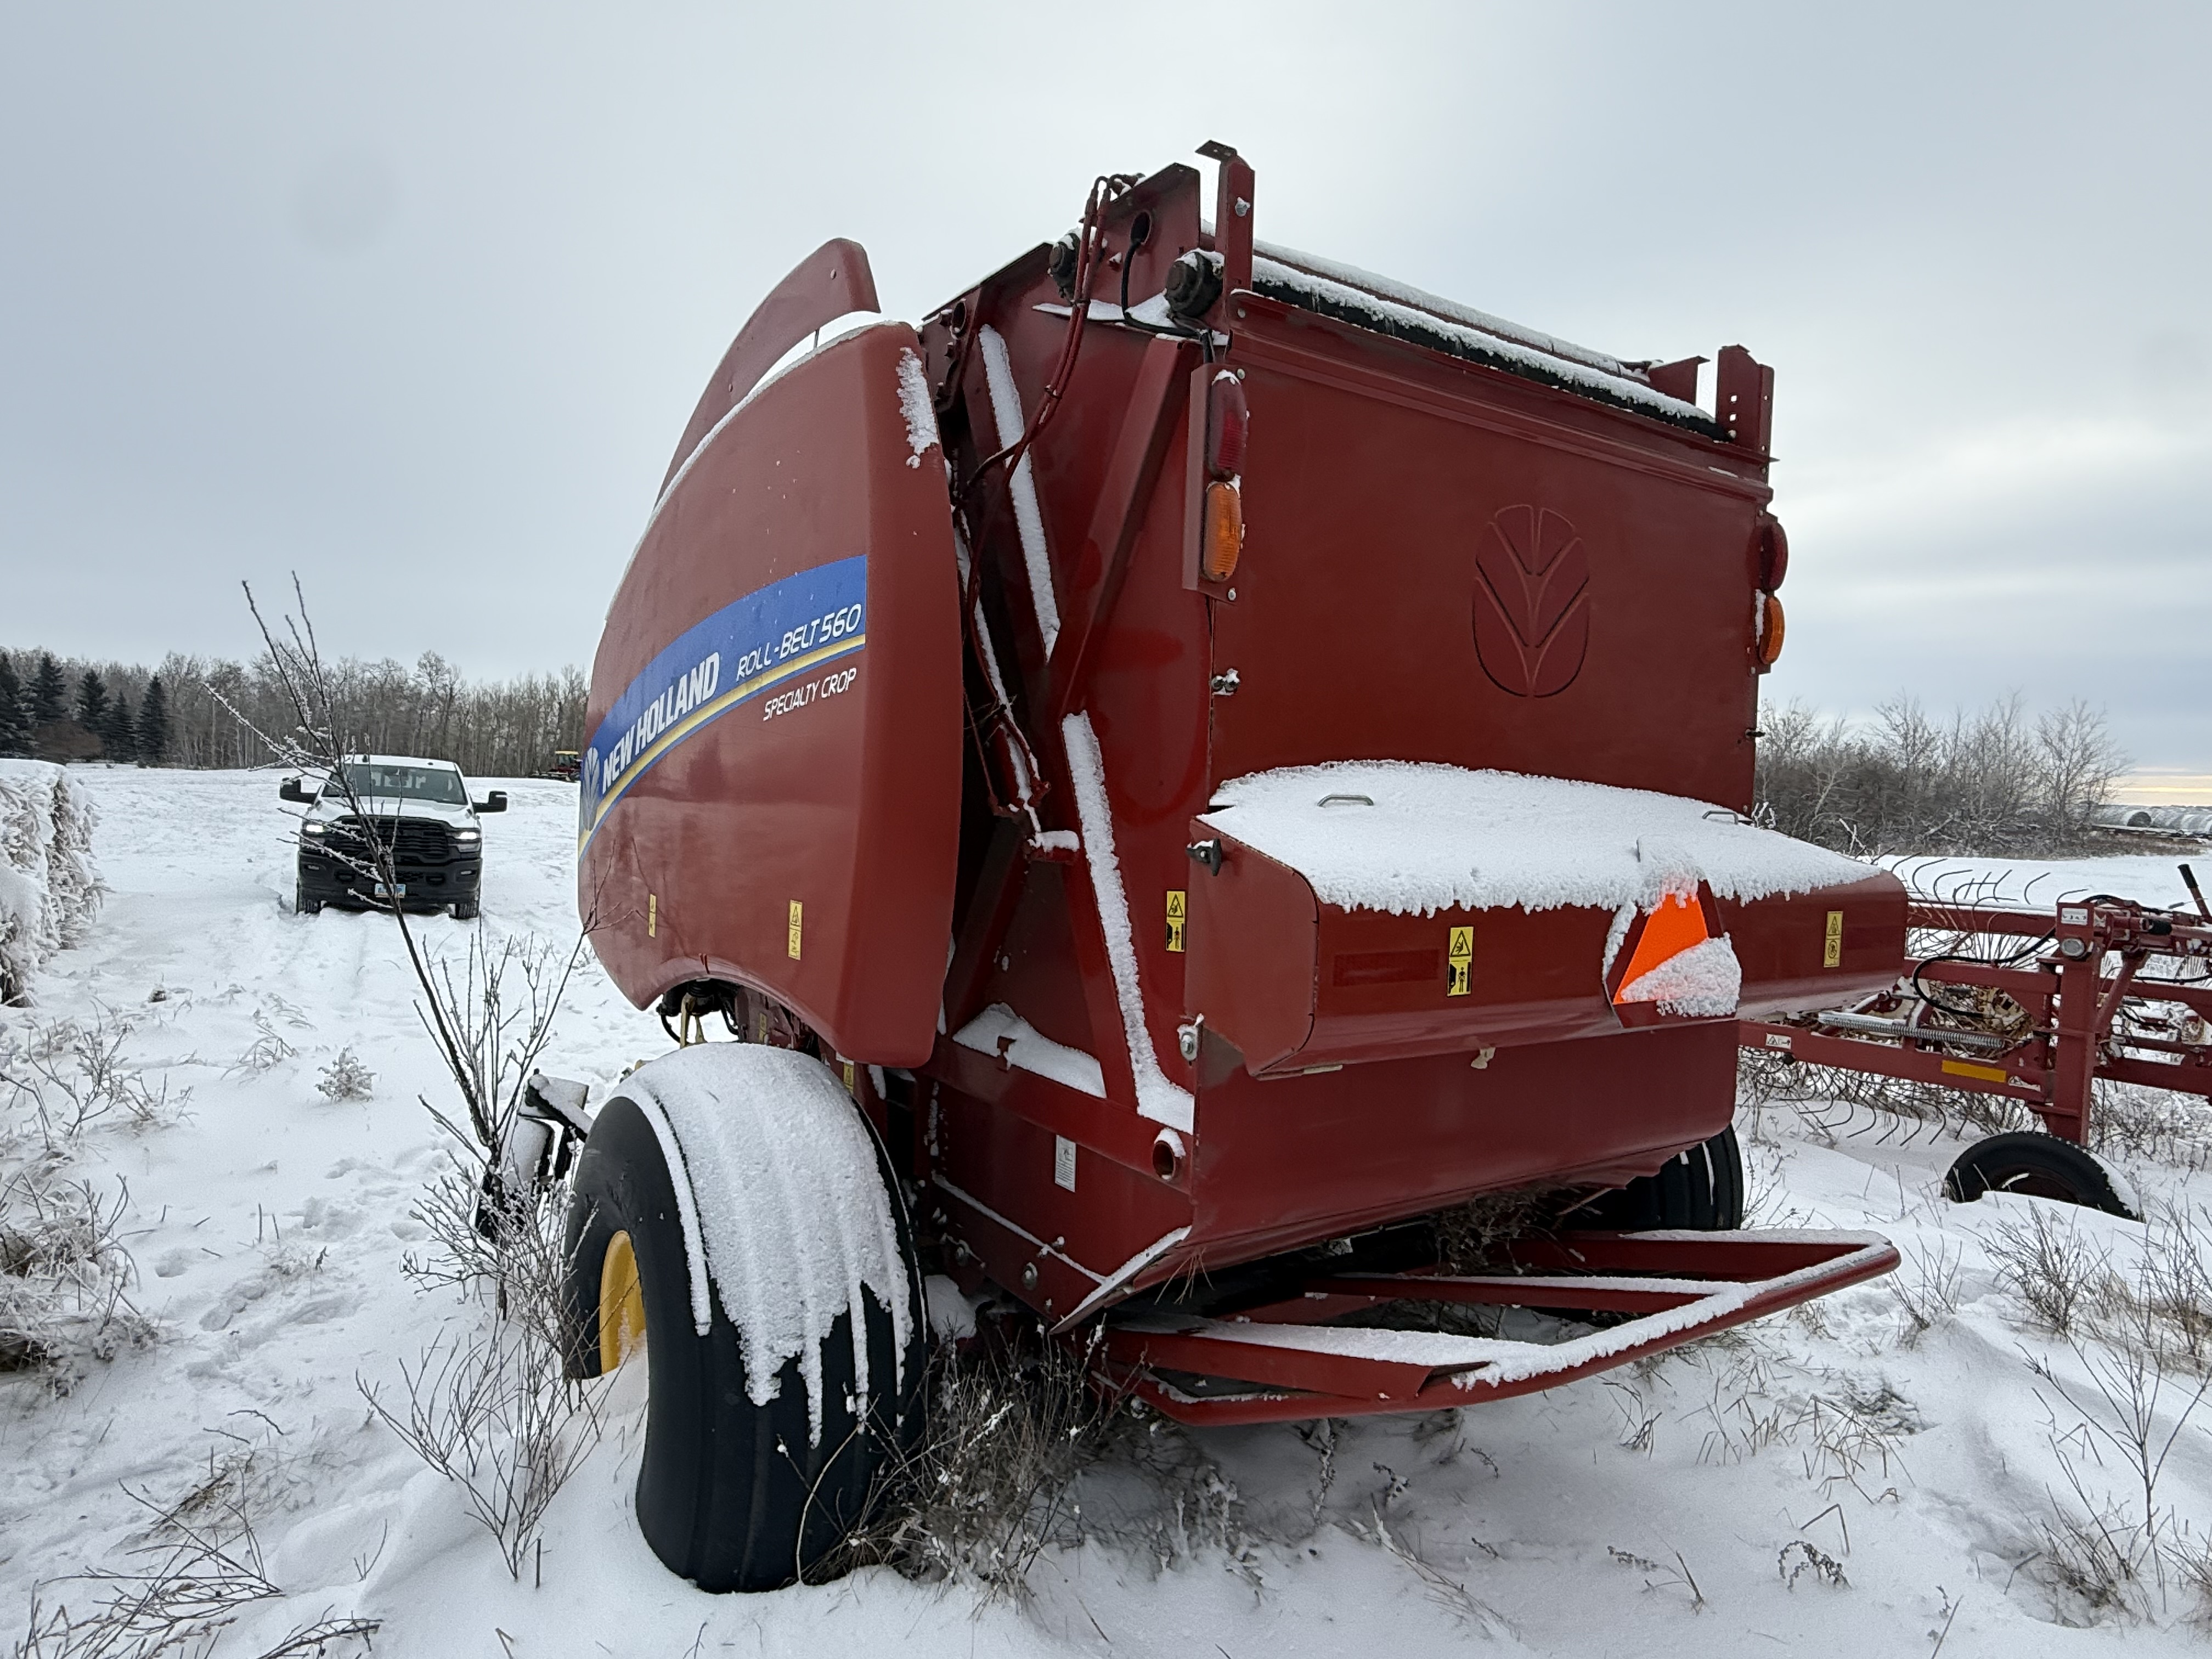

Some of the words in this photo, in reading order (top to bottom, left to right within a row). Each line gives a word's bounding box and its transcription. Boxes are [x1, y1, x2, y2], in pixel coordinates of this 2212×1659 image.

[819, 603, 862, 644] 560
[763, 680, 821, 722] SPECIALTY
[821, 667, 857, 699] CROP
[602, 724, 635, 794] NEW
[635, 652, 720, 756] HOLLAND
